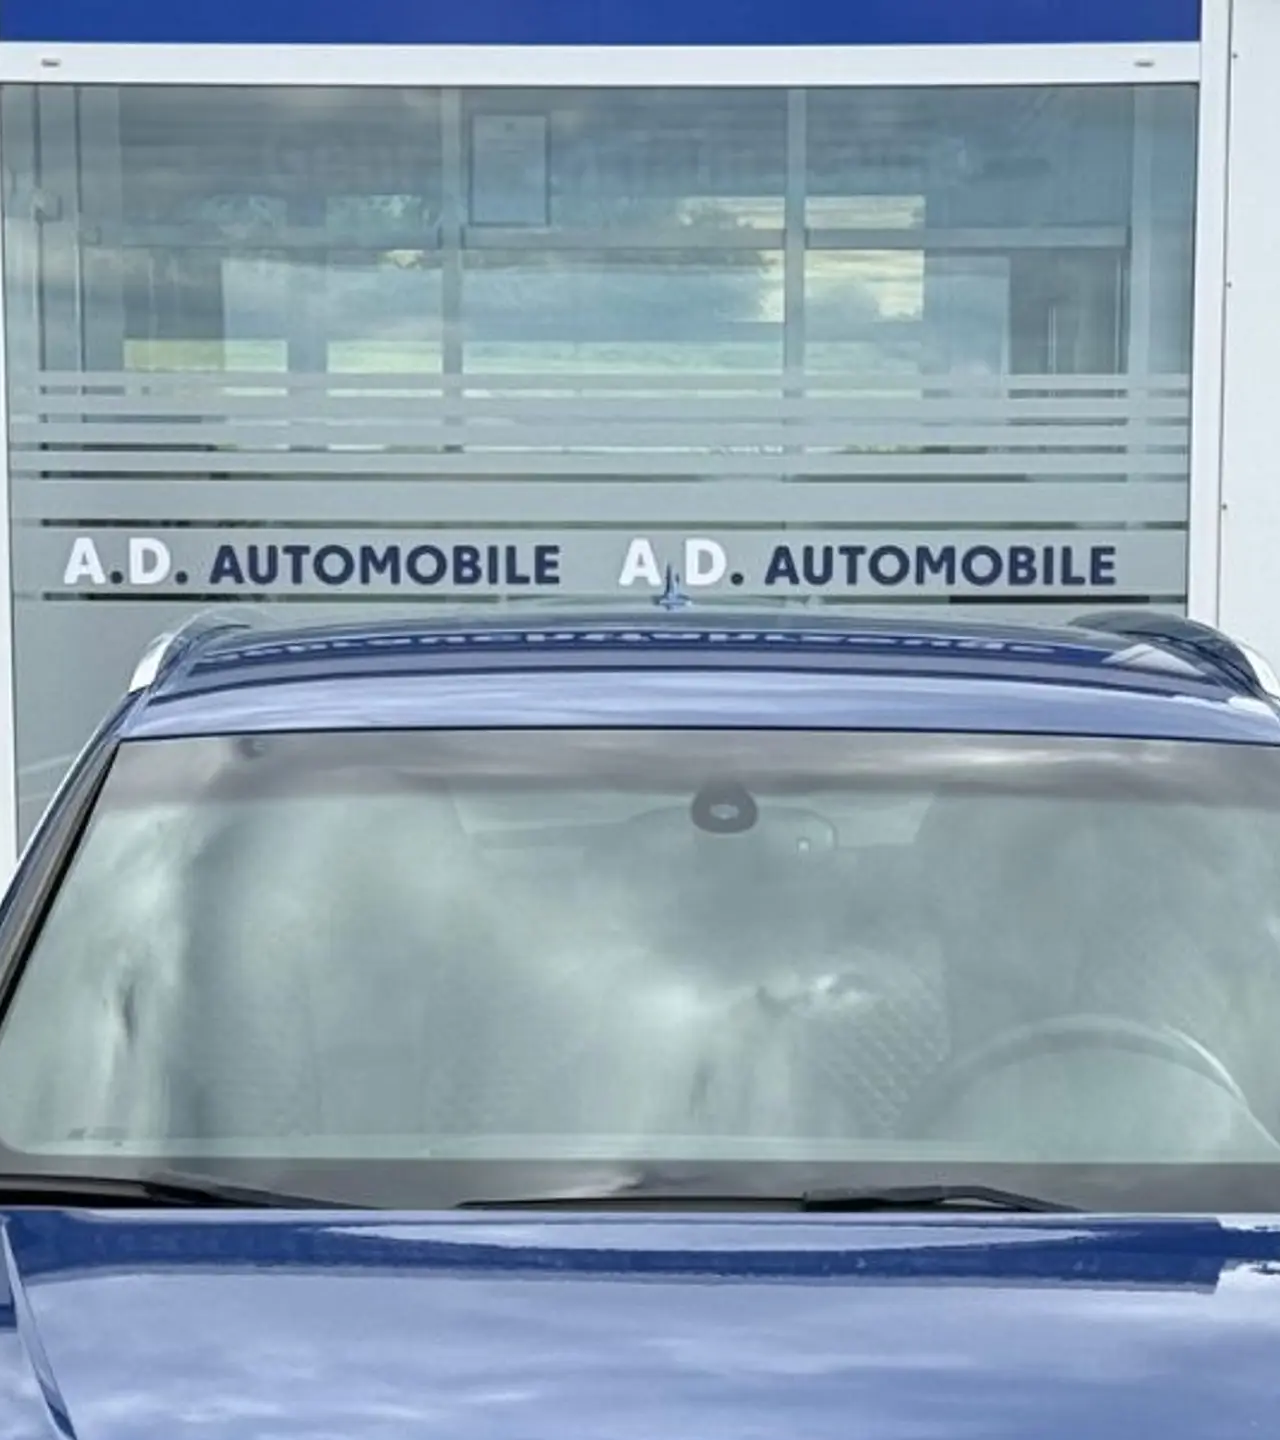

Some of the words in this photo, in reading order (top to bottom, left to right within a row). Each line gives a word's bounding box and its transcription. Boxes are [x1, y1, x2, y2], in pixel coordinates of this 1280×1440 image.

[63, 536, 189, 586] A.D.
[208, 543, 561, 586] AUTOMOBILE
[618, 537, 745, 587] AD.
[764, 544, 1117, 587] AUTOMOBILE
